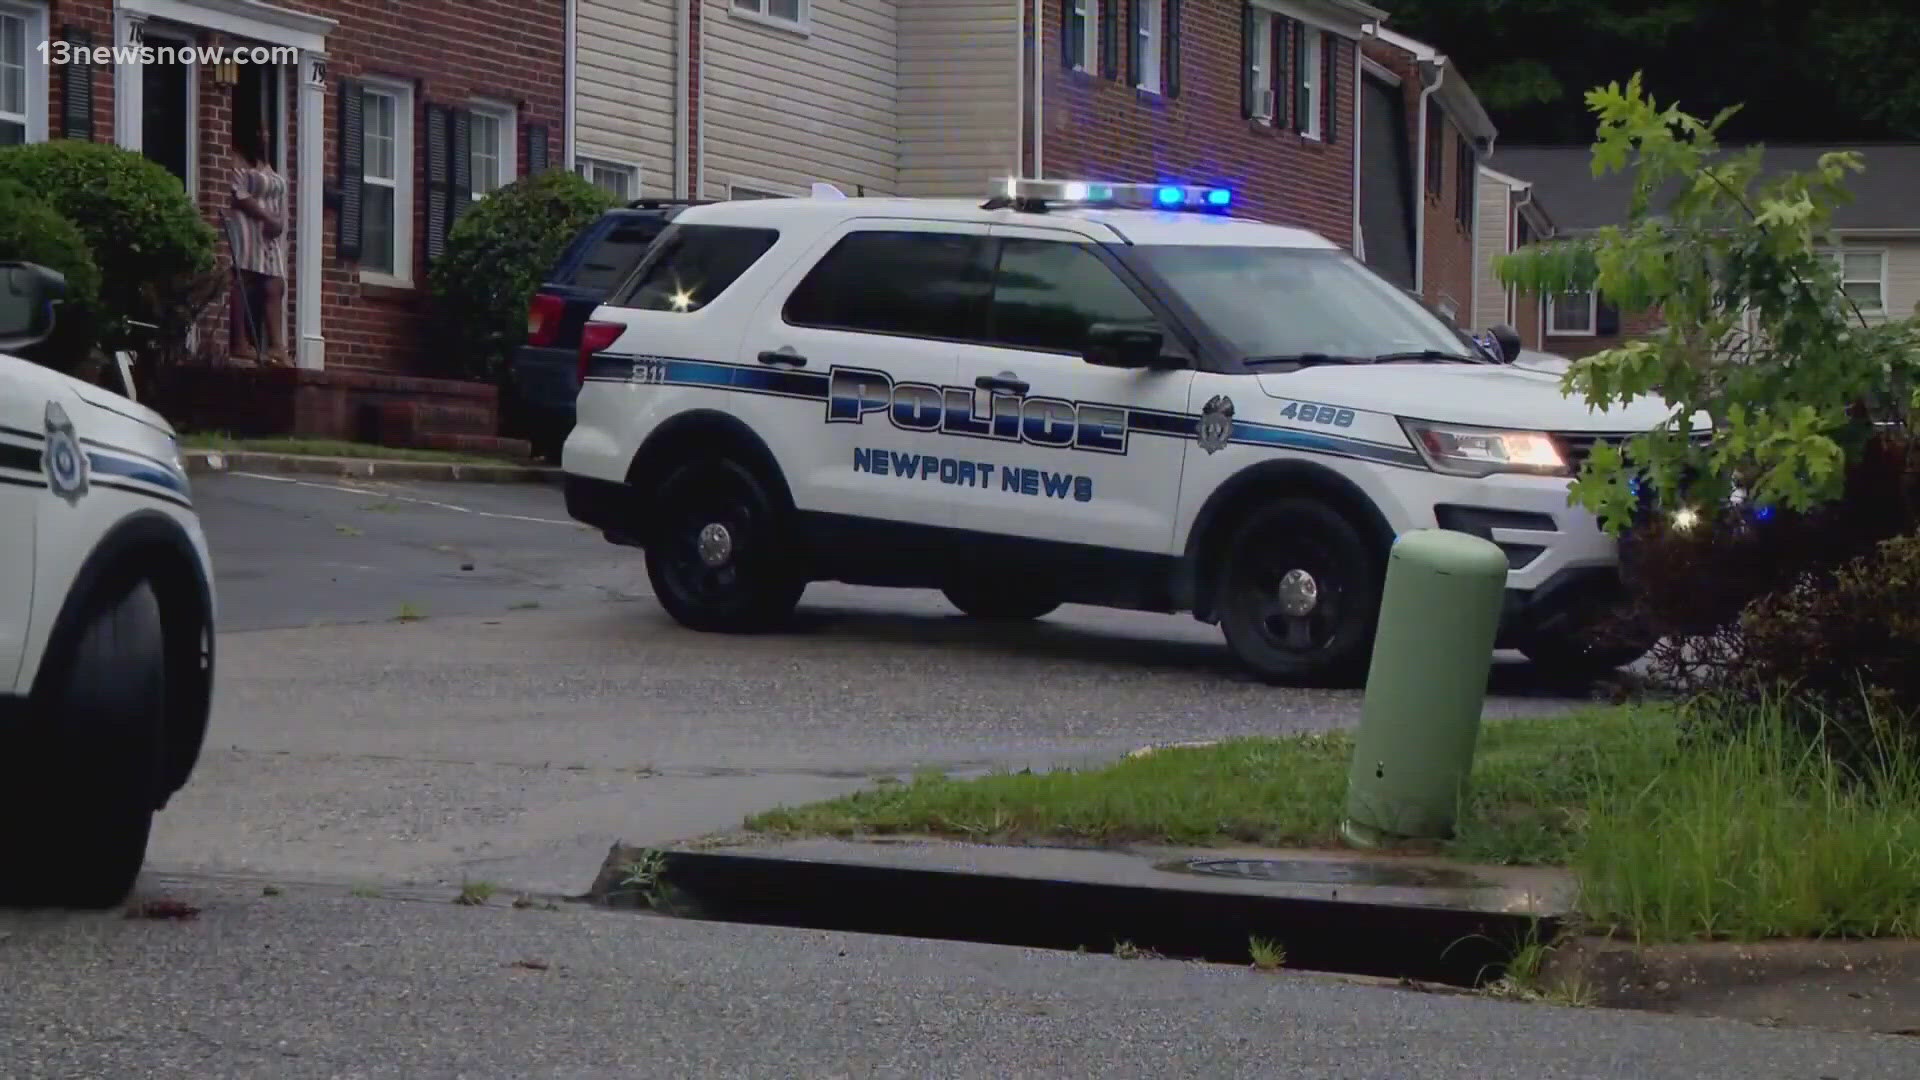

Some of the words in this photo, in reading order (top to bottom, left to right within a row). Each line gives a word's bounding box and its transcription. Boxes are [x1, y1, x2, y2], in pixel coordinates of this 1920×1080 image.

[825, 364, 1128, 456] POLICE
[853, 447, 994, 489] NEWPORT
[1001, 466, 1092, 502] NEWS
